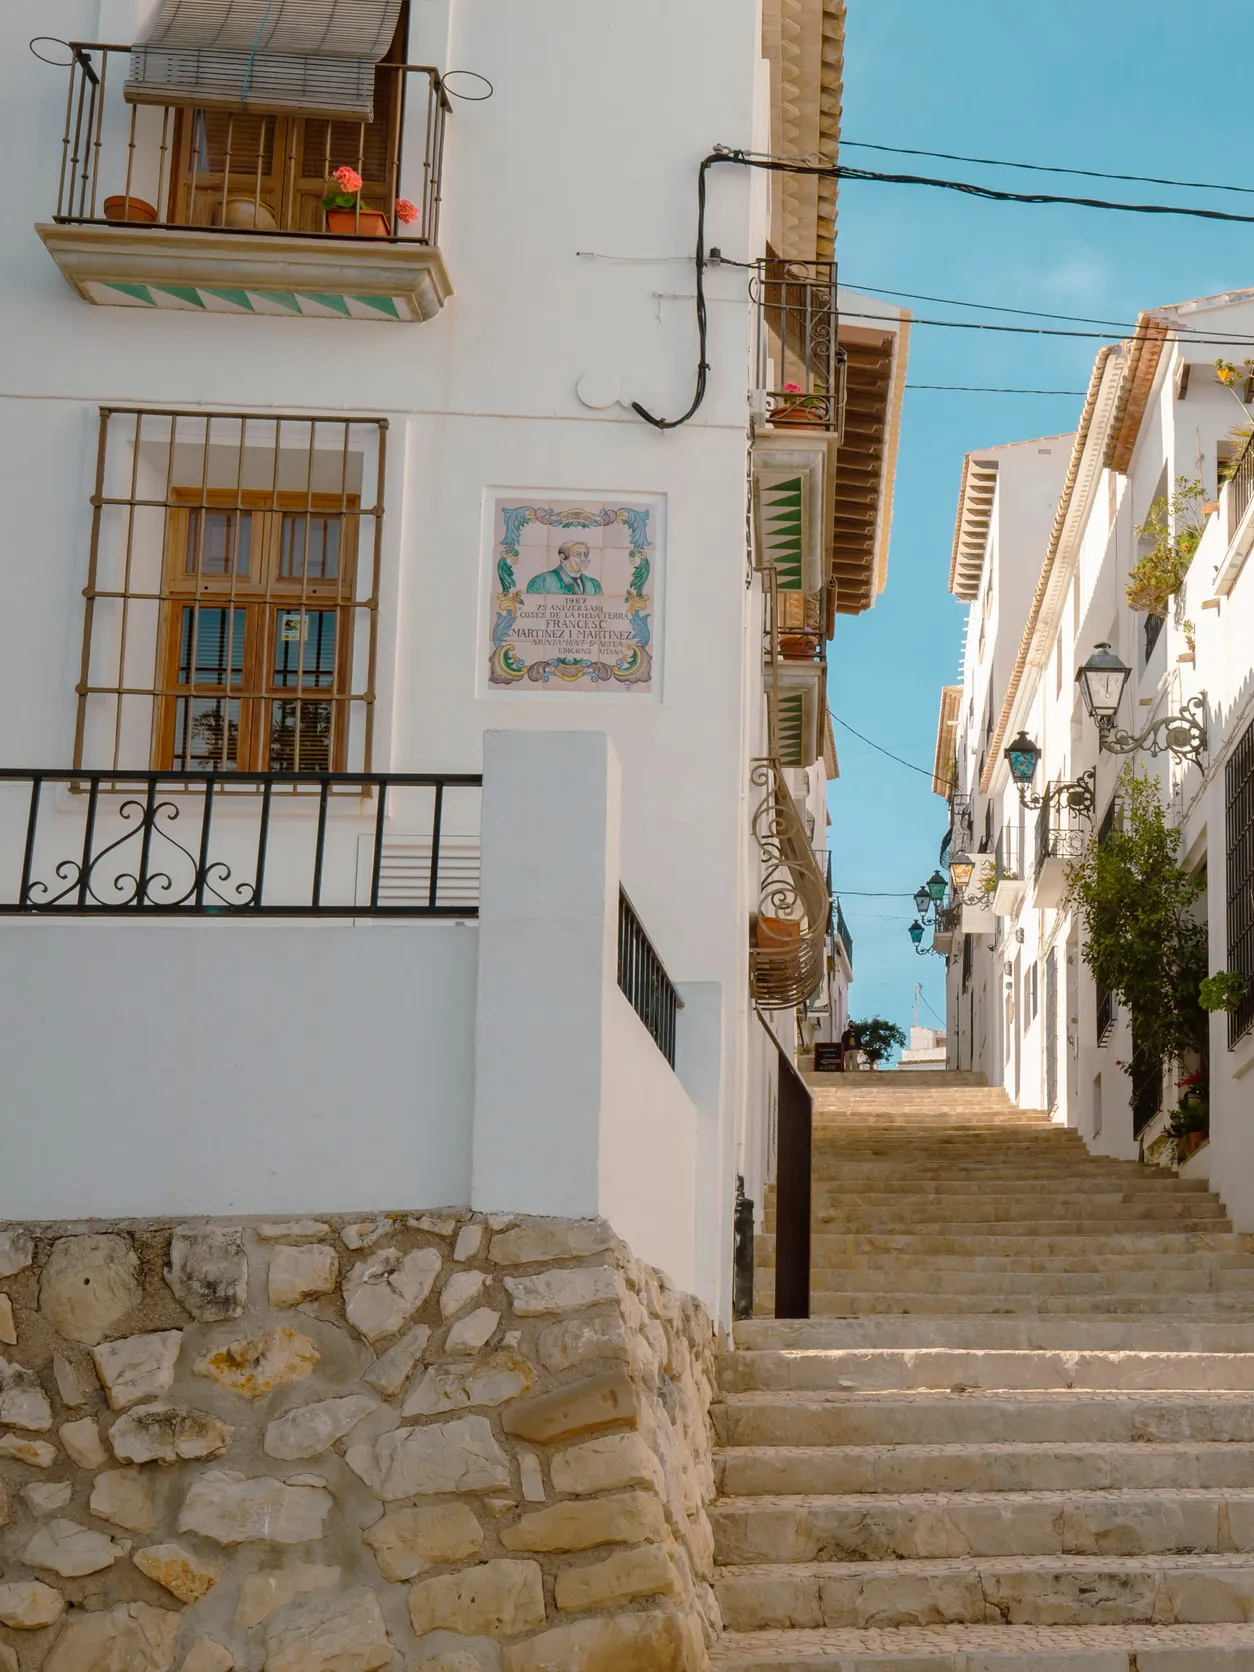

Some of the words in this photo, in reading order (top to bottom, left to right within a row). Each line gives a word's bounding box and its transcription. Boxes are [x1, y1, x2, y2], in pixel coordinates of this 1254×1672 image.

[549, 604, 603, 612] ANIVERSARI
[549, 611, 561, 619] DE
[577, 612, 600, 620] MEUA
[546, 619, 607, 629] FRANCESC
[511, 628, 565, 638] MARTINEZ
[576, 630, 632, 640] MARTINEZ
[531, 639, 585, 647] AJUNTAMENT
[558, 647, 592, 655] EDICIONS
[599, 648, 624, 656] AITANA
